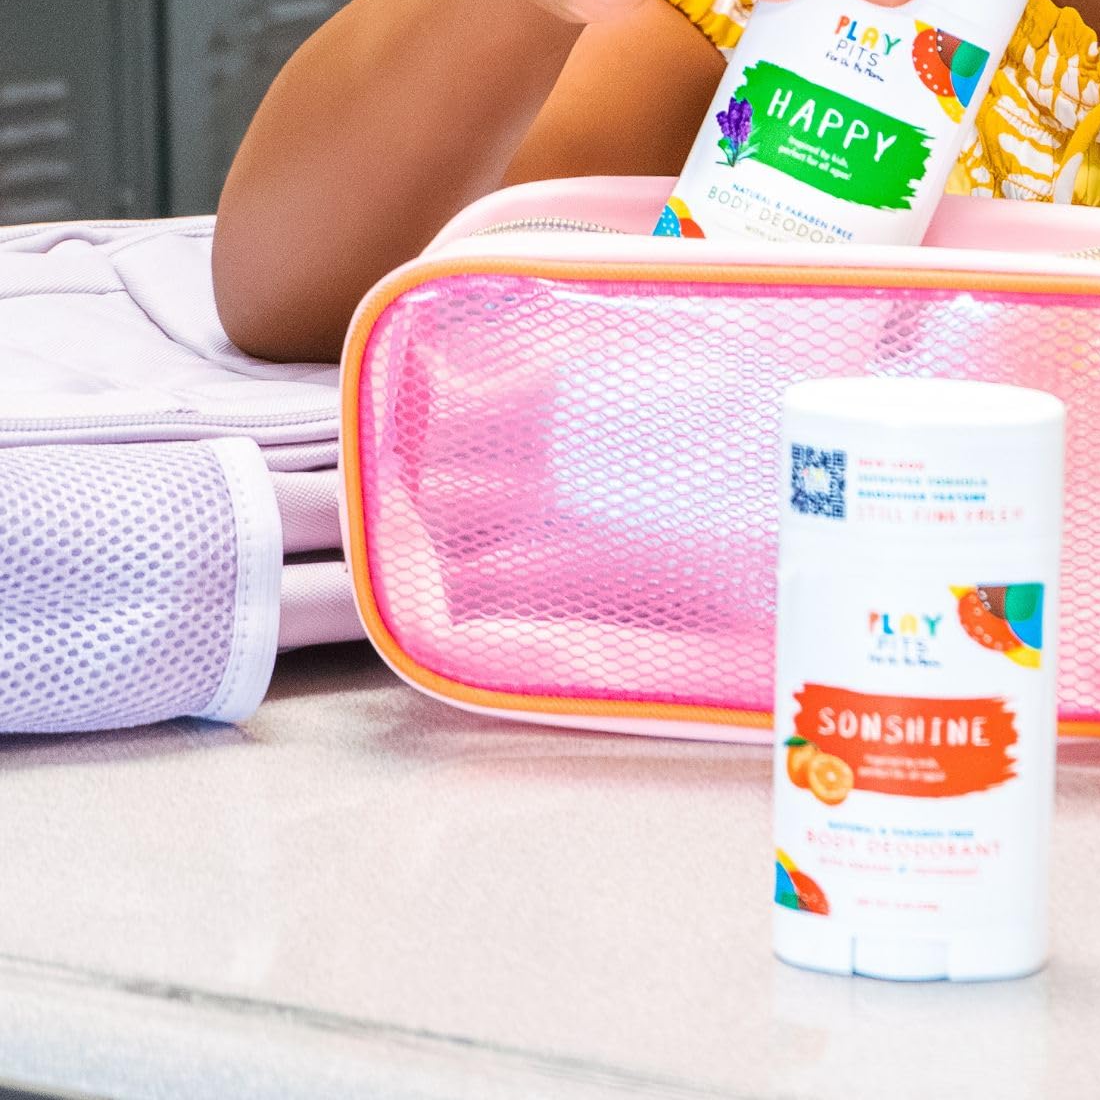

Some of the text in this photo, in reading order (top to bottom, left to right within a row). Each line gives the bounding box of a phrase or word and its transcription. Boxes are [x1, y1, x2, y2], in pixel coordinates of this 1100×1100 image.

[835, 15, 901, 55] PLAY
[836, 39, 880, 66] PITS
[767, 88, 897, 162] HAPPY
[708, 186, 846, 244] BODY DEODOR
[732, 183, 854, 241] NATURAL & PARABEN FREE
[868, 612, 942, 637] PLAY
[817, 707, 991, 747] SONSHINE
[807, 829, 1001, 856] BODY DEODORANT
